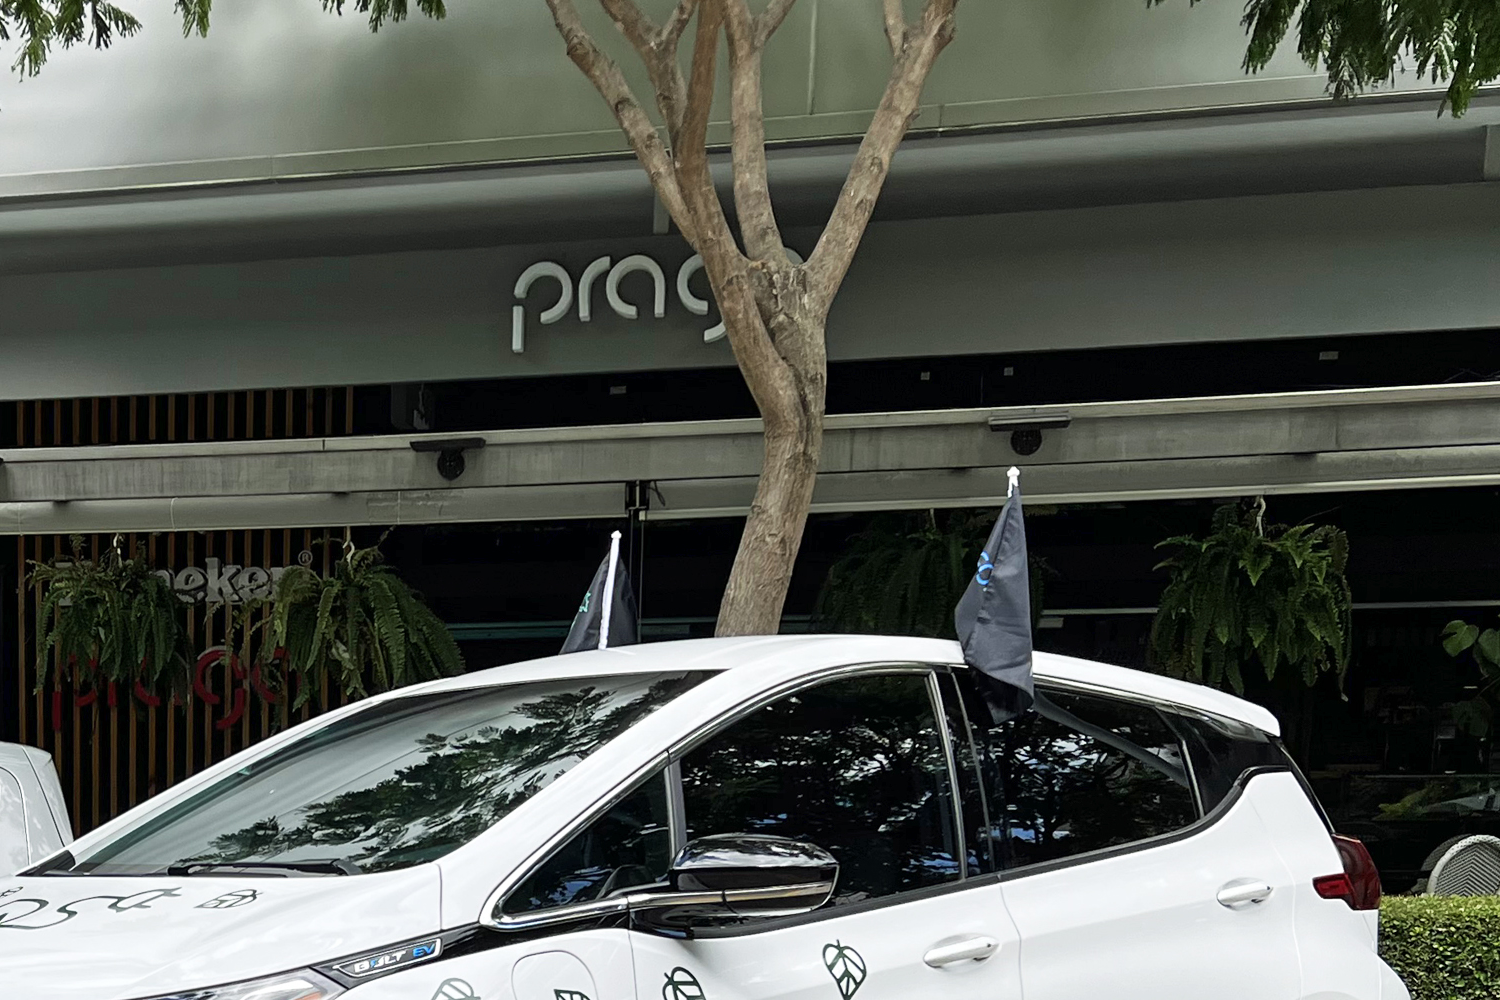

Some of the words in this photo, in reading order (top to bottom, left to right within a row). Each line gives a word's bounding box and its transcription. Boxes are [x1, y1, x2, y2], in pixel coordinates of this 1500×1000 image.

[512, 247, 804, 353] prag
[353, 949, 407, 973] BOLT
[412, 943, 435, 957] EV
